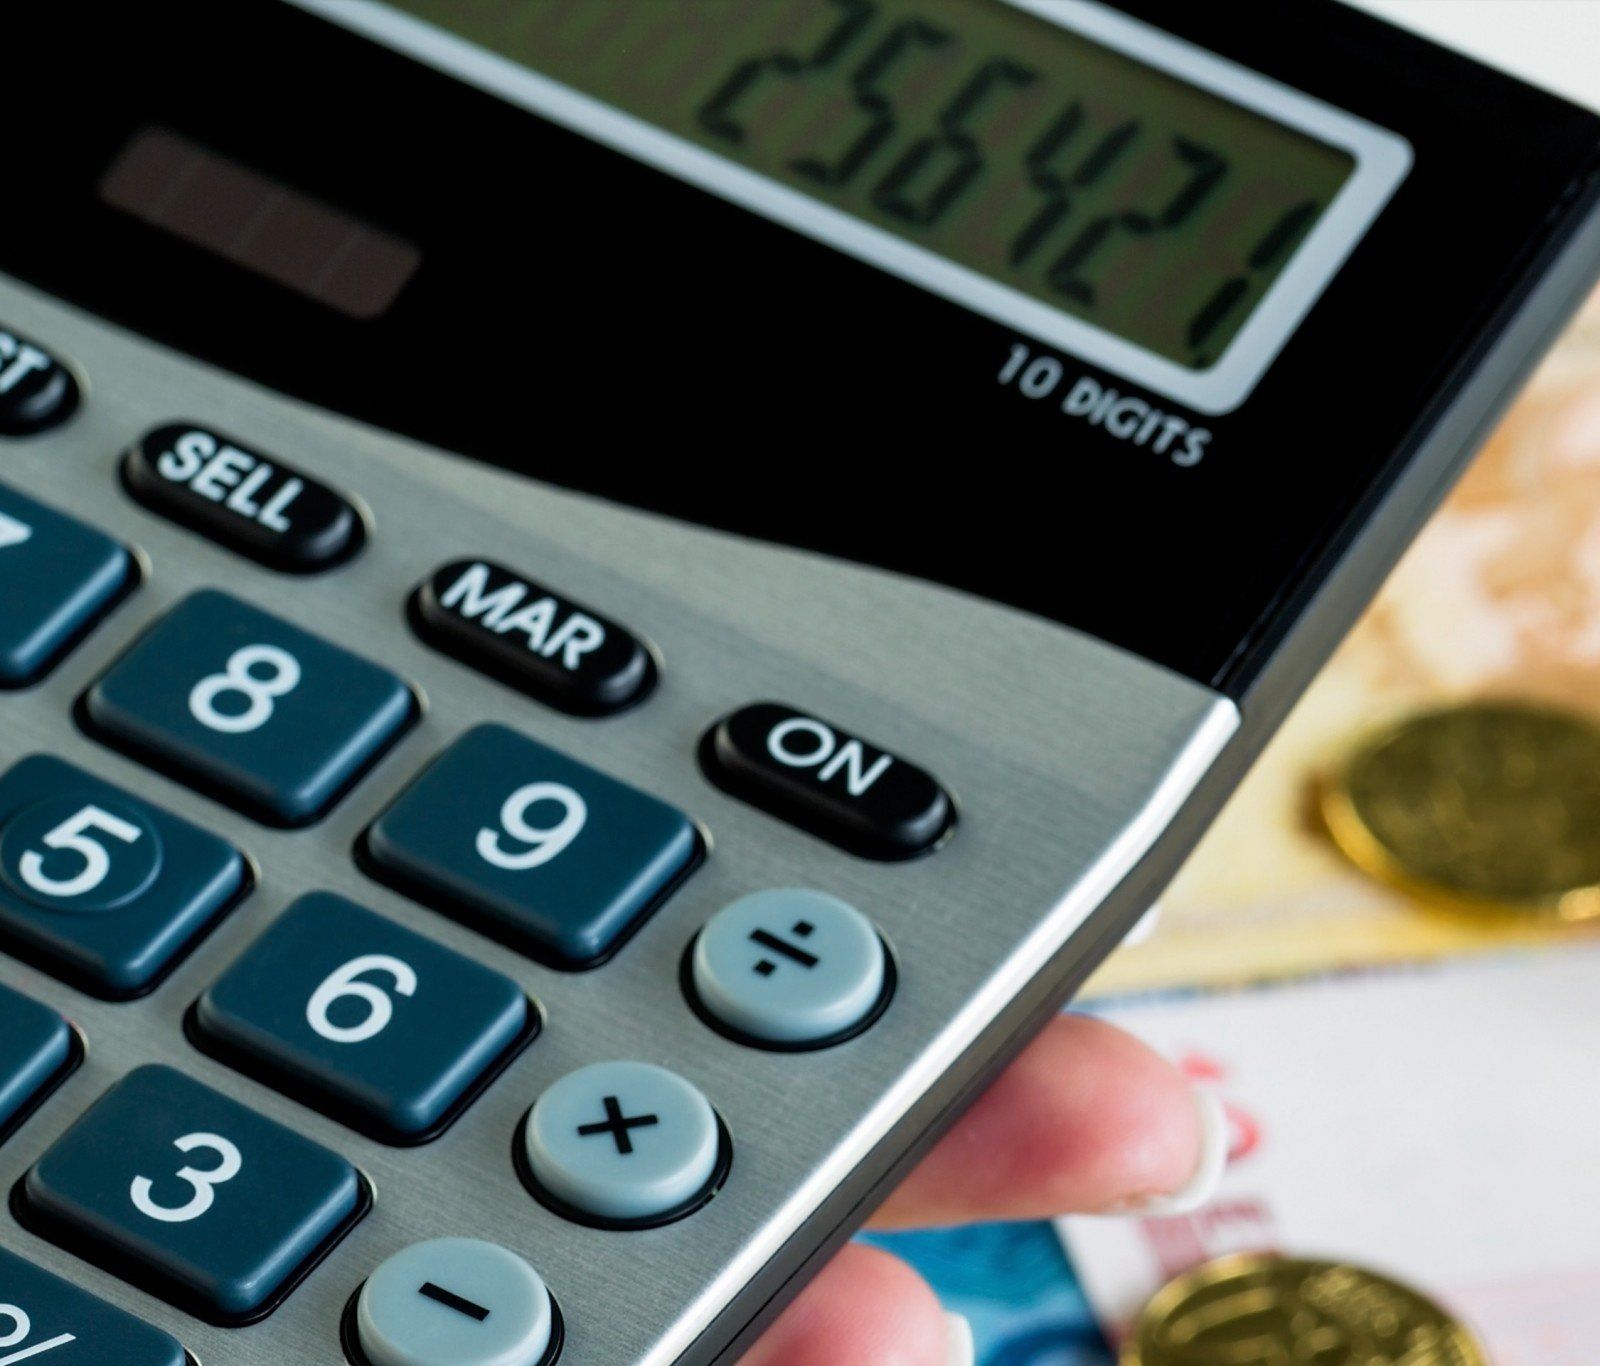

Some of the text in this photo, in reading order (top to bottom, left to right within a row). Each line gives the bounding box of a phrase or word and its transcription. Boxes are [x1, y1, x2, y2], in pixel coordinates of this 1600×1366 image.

[697, 0, 1313, 368] 256421
[997, 344, 1213, 469] 10 DIGITS
[157, 432, 304, 534] SELL
[441, 562, 606, 671] MAR
[189, 644, 301, 733] 8
[766, 717, 893, 797] ON
[18, 804, 143, 897] 5
[475, 781, 588, 870] 9
[305, 953, 418, 1043] 6
[129, 1131, 242, 1223] 3
